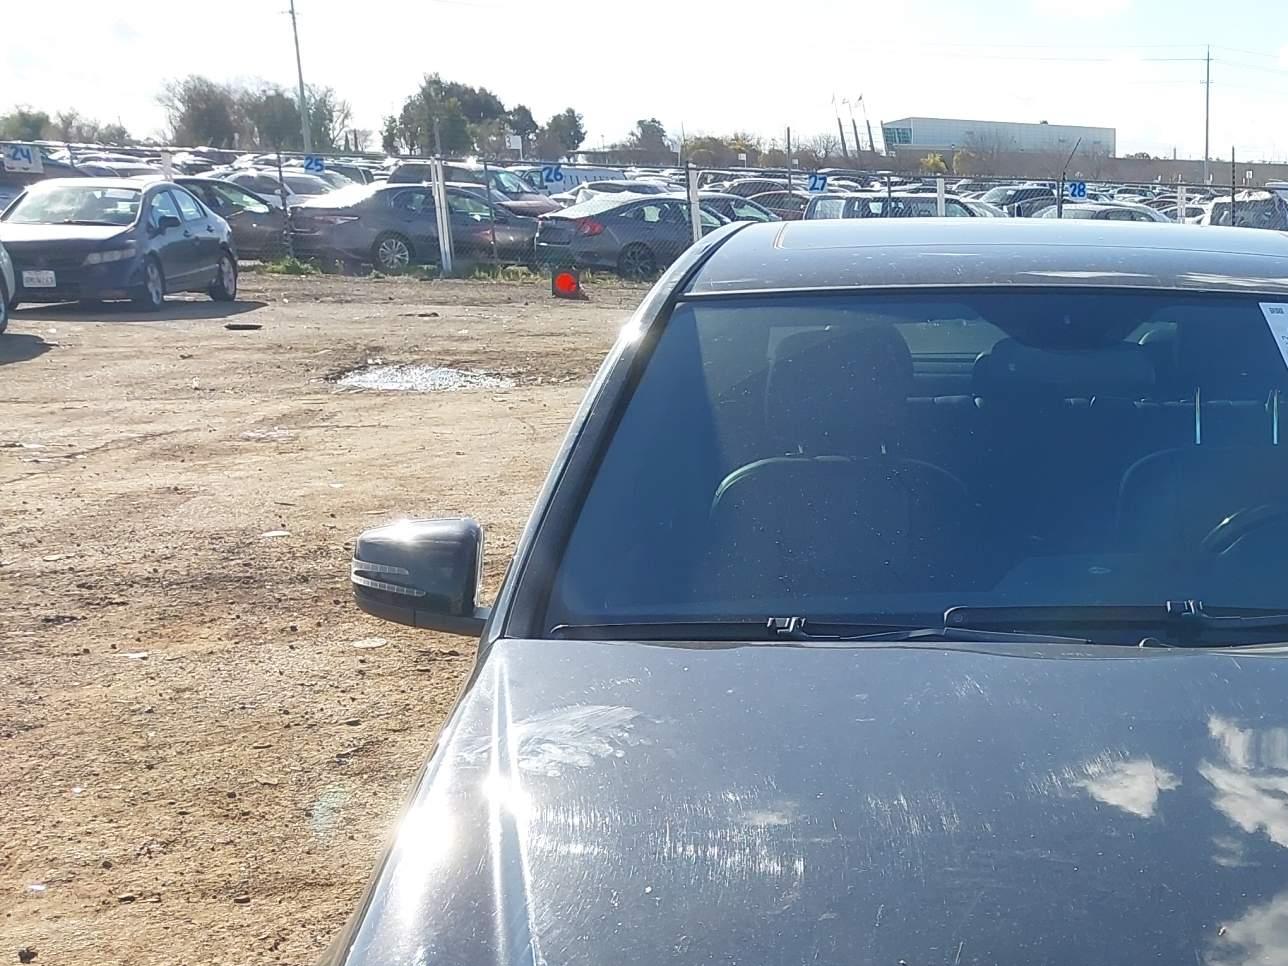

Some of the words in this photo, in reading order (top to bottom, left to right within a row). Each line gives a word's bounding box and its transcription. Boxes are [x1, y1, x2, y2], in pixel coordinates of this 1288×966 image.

[10, 146, 32, 163] 24
[304, 156, 324, 171] 25
[542, 166, 563, 182] 26
[809, 175, 827, 191] 27
[1070, 182, 1086, 197] 28
